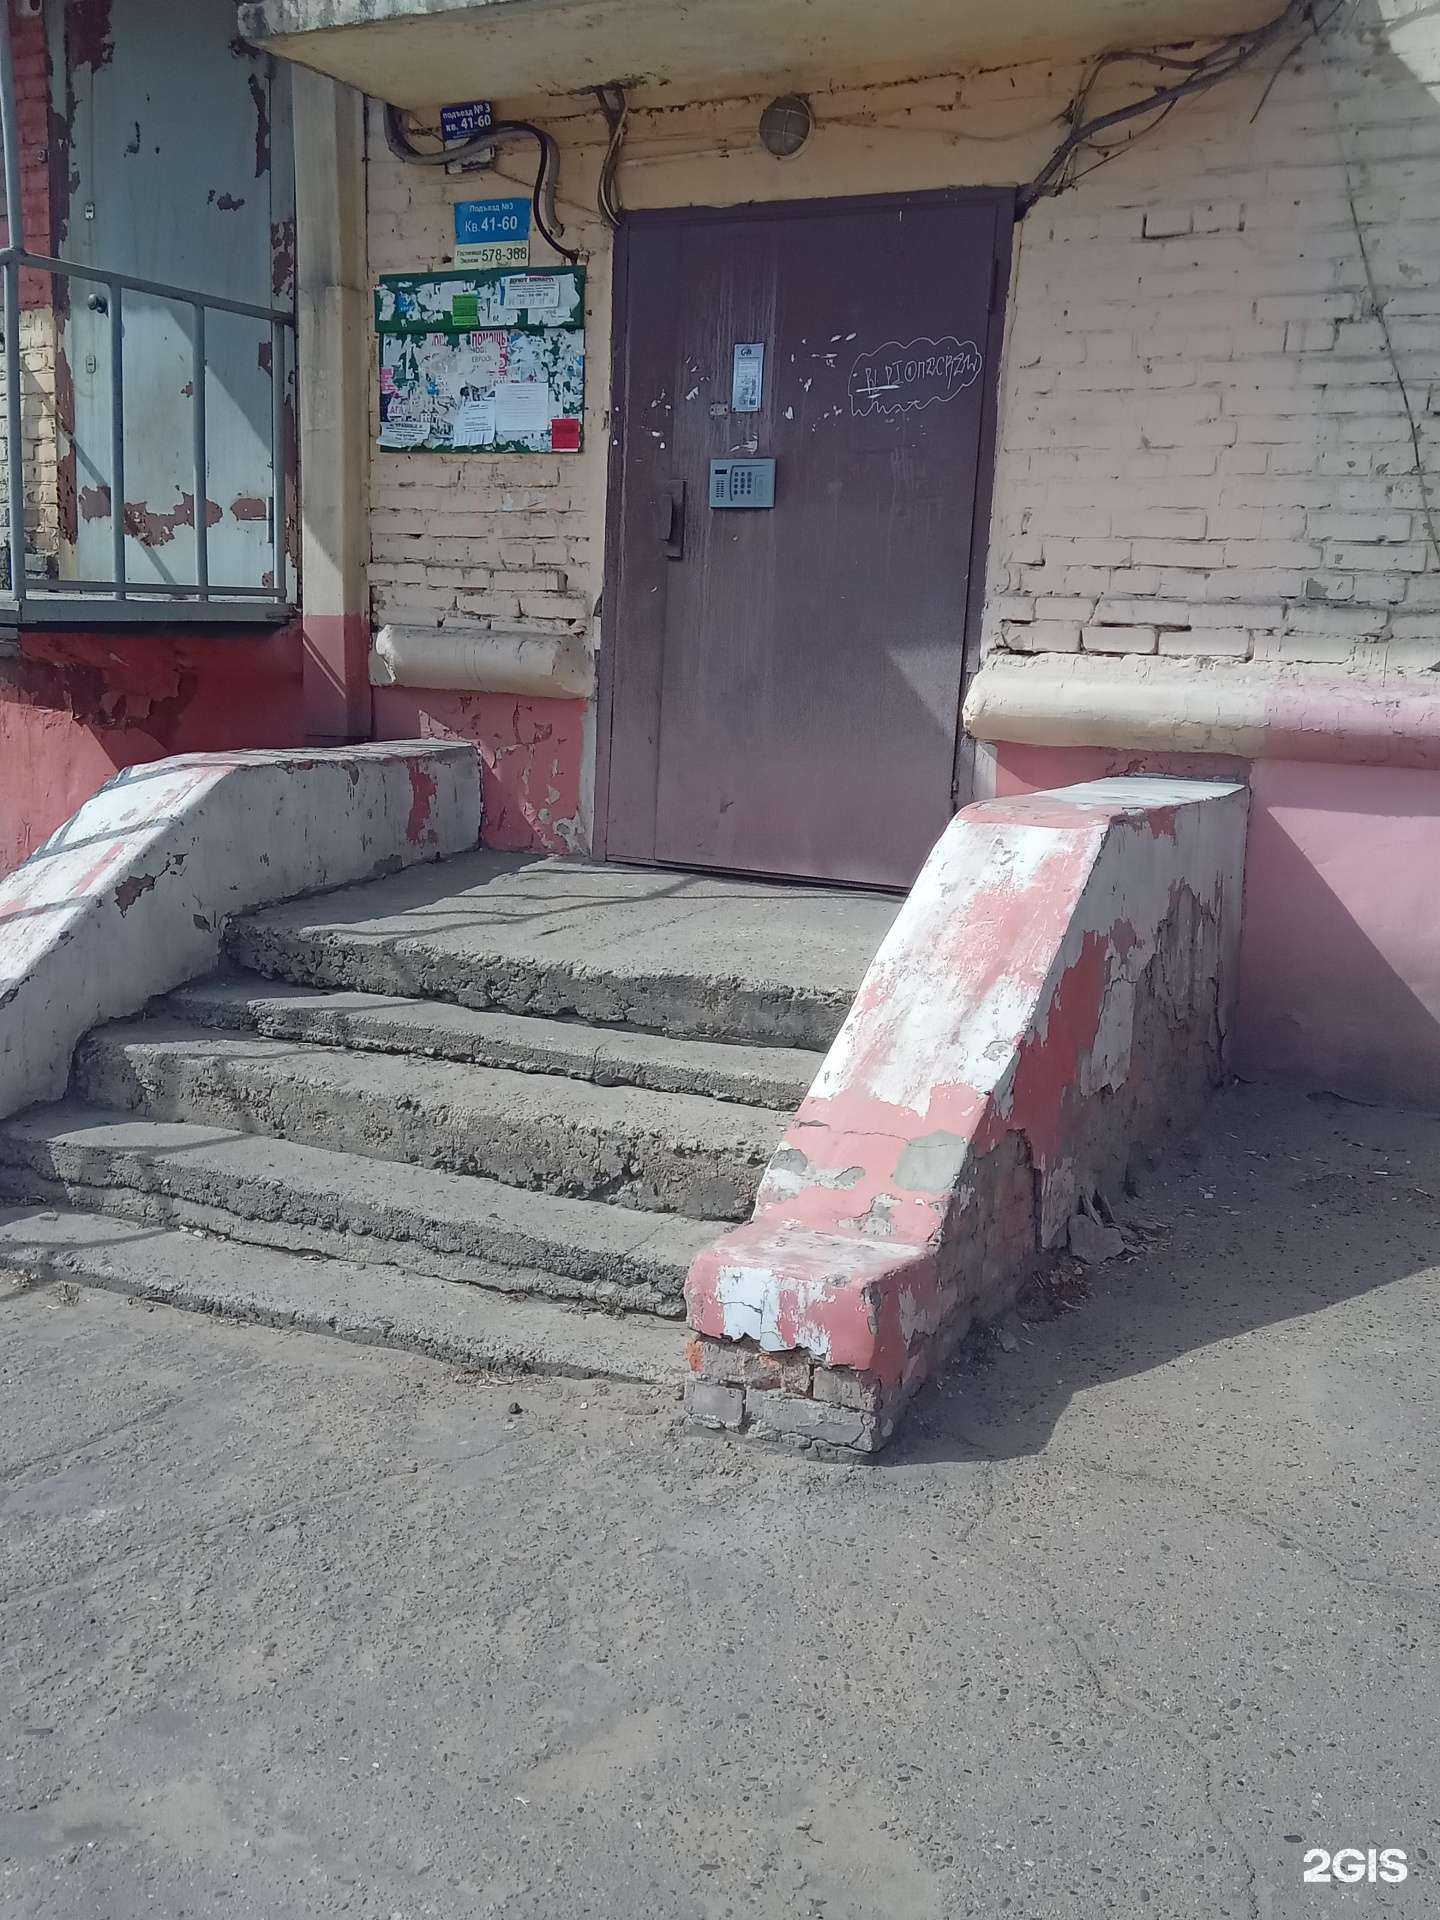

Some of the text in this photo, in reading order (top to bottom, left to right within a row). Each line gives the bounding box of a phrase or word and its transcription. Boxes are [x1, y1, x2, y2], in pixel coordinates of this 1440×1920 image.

[442, 110, 474, 120] подъезд
[484, 103, 491, 114] 3
[445, 114, 492, 132] кв. 41-60
[469, 204, 501, 214] Подъезд
